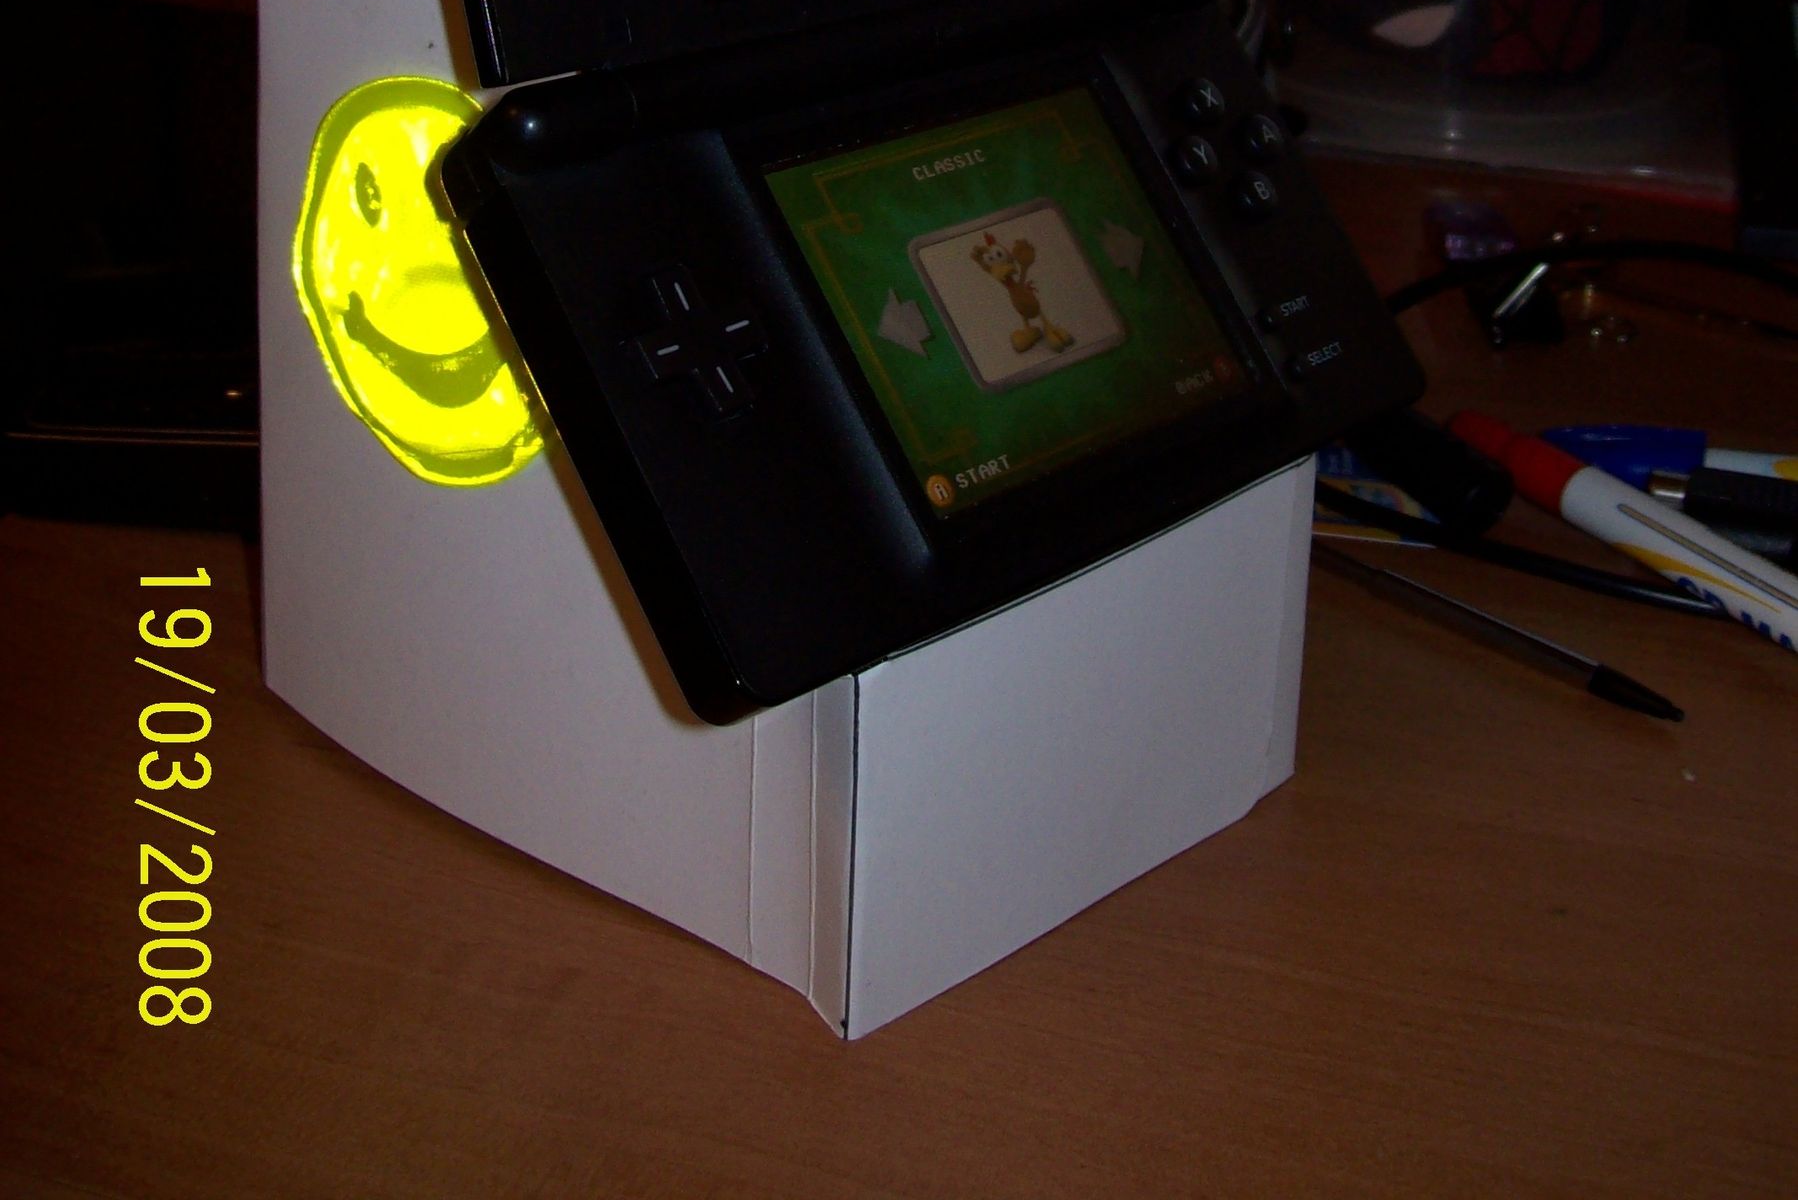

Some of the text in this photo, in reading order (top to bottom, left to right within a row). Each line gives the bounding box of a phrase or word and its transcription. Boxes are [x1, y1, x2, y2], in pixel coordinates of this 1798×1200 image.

[1200, 87, 1218, 108] X
[1260, 123, 1278, 145] A
[912, 148, 985, 181] CLASSIC
[1191, 145, 1209, 166] Y
[1253, 180, 1270, 201] B
[1280, 295, 1311, 317] START
[1307, 341, 1342, 367] SELECT
[955, 454, 1011, 489] START
